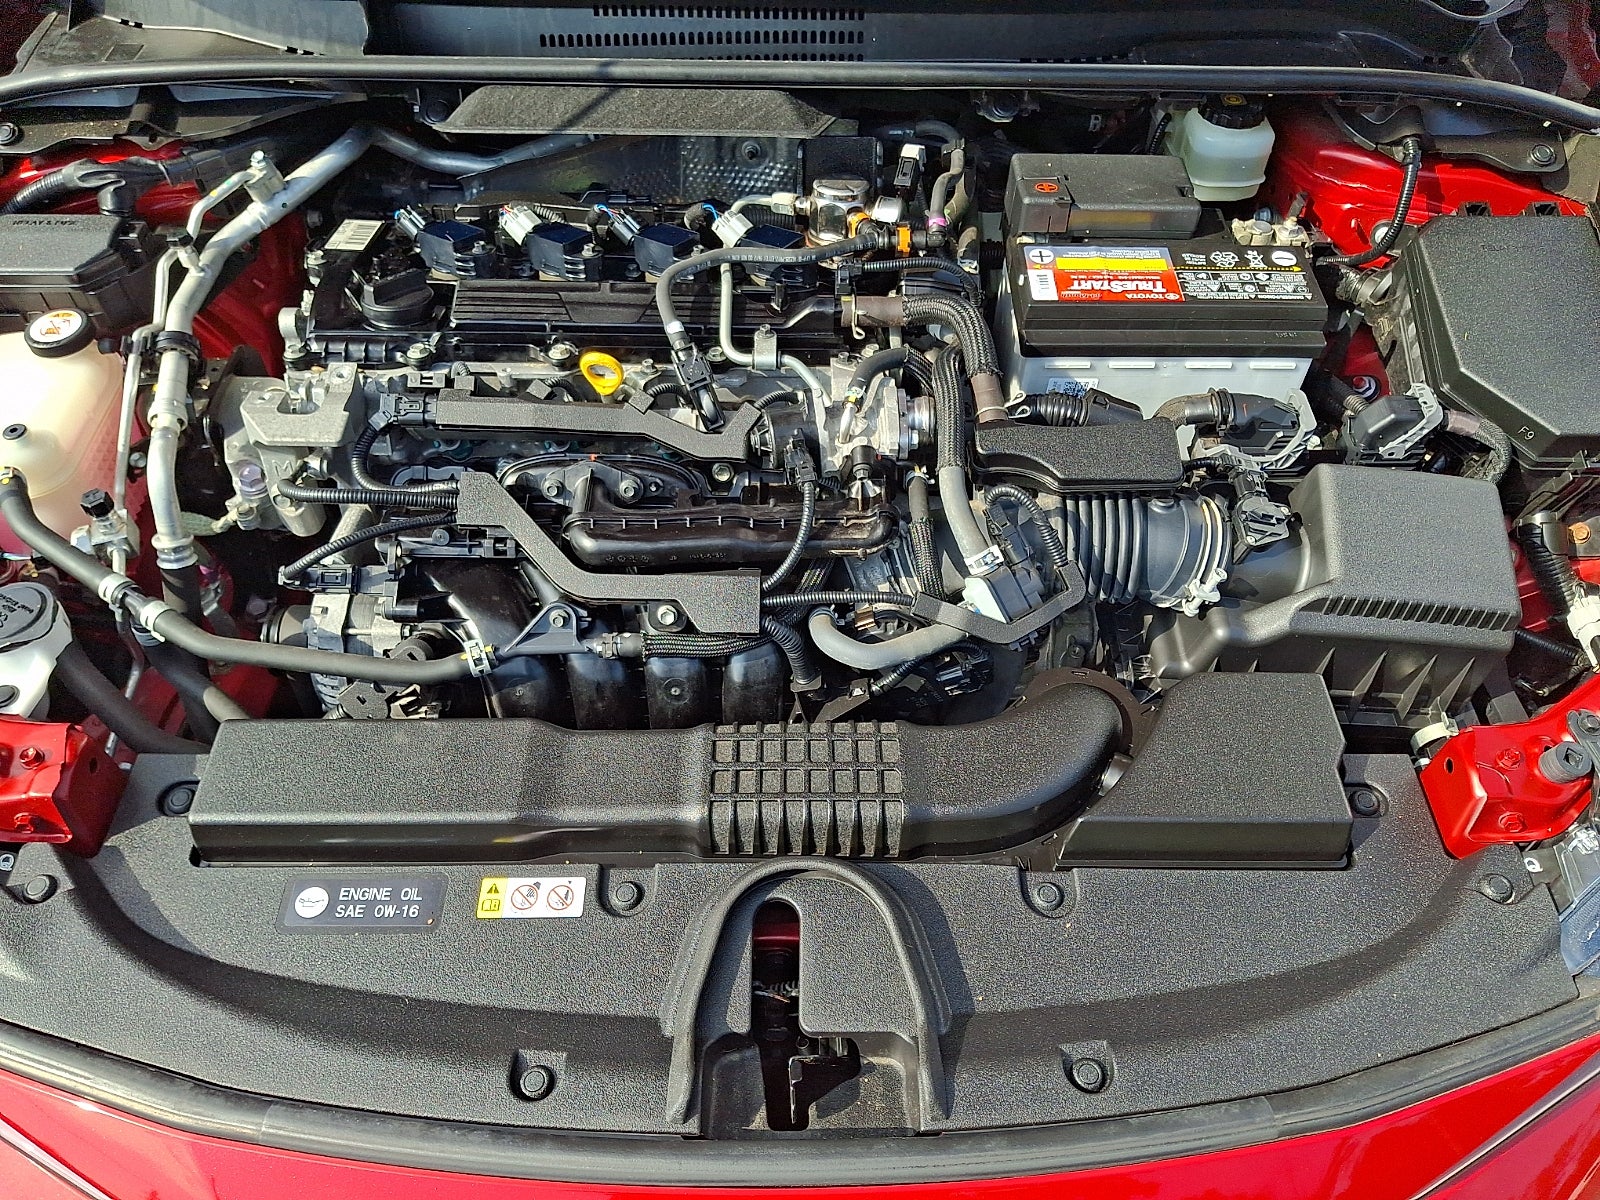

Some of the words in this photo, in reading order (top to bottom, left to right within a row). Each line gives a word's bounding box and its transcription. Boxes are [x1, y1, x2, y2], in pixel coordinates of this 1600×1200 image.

[1517, 425, 1535, 440] F9
[338, 887, 392, 901] ENGINE
[400, 887, 423, 901] OIL
[335, 904, 366, 918] SAE
[374, 904, 420, 918] 0W-16
